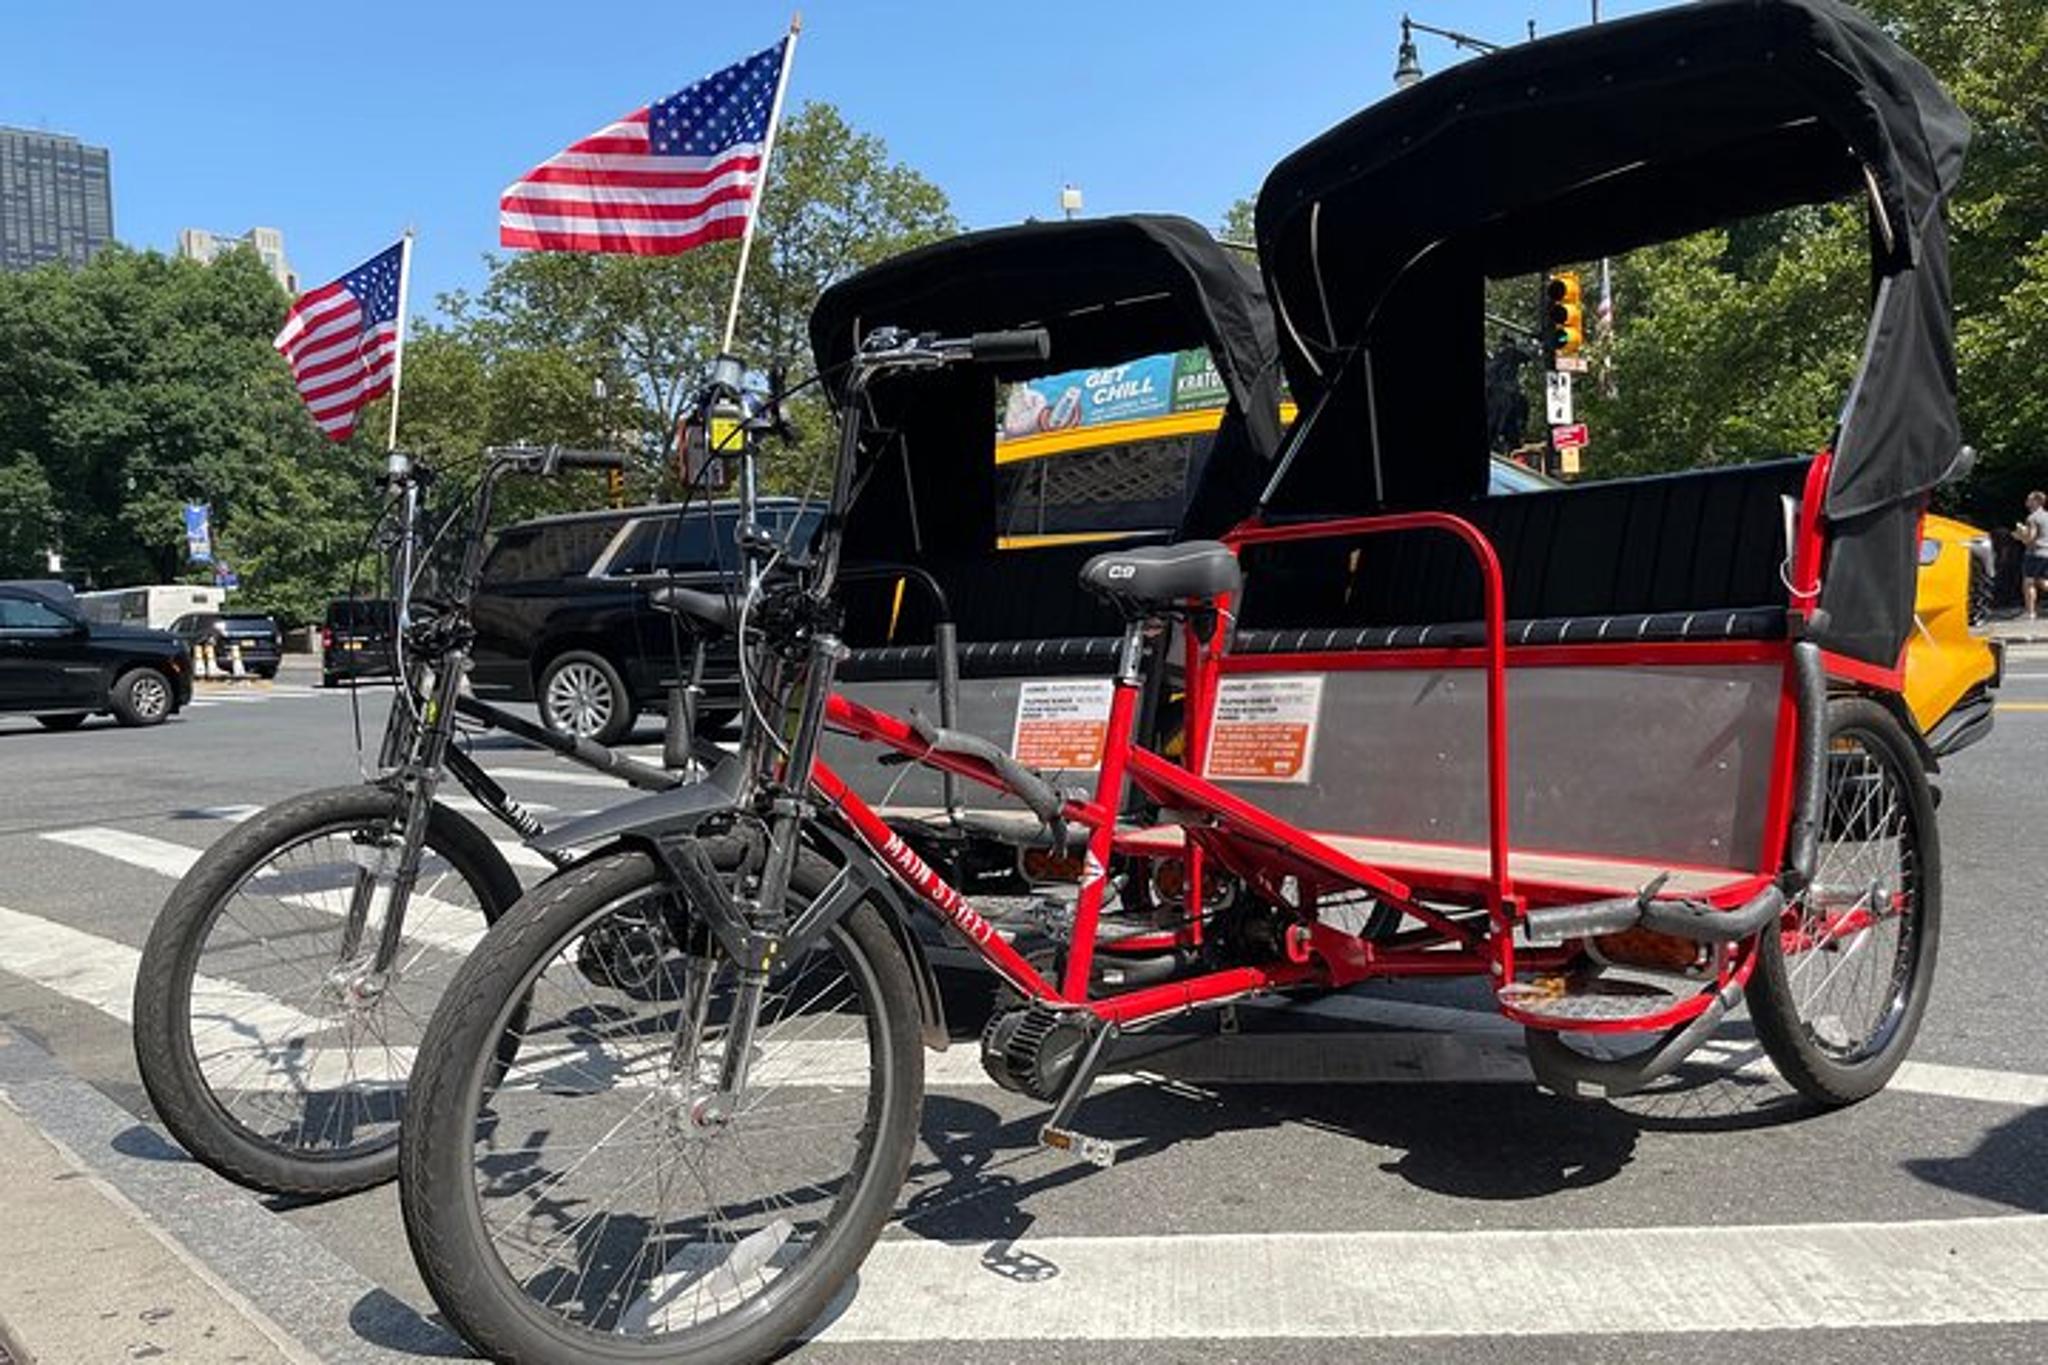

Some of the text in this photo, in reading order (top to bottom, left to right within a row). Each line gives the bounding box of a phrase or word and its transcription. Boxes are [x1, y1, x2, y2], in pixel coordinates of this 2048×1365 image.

[1086, 366, 1130, 388] GET
[1093, 377, 1155, 405] CHILL
[884, 832, 993, 945] MAIN STREET
